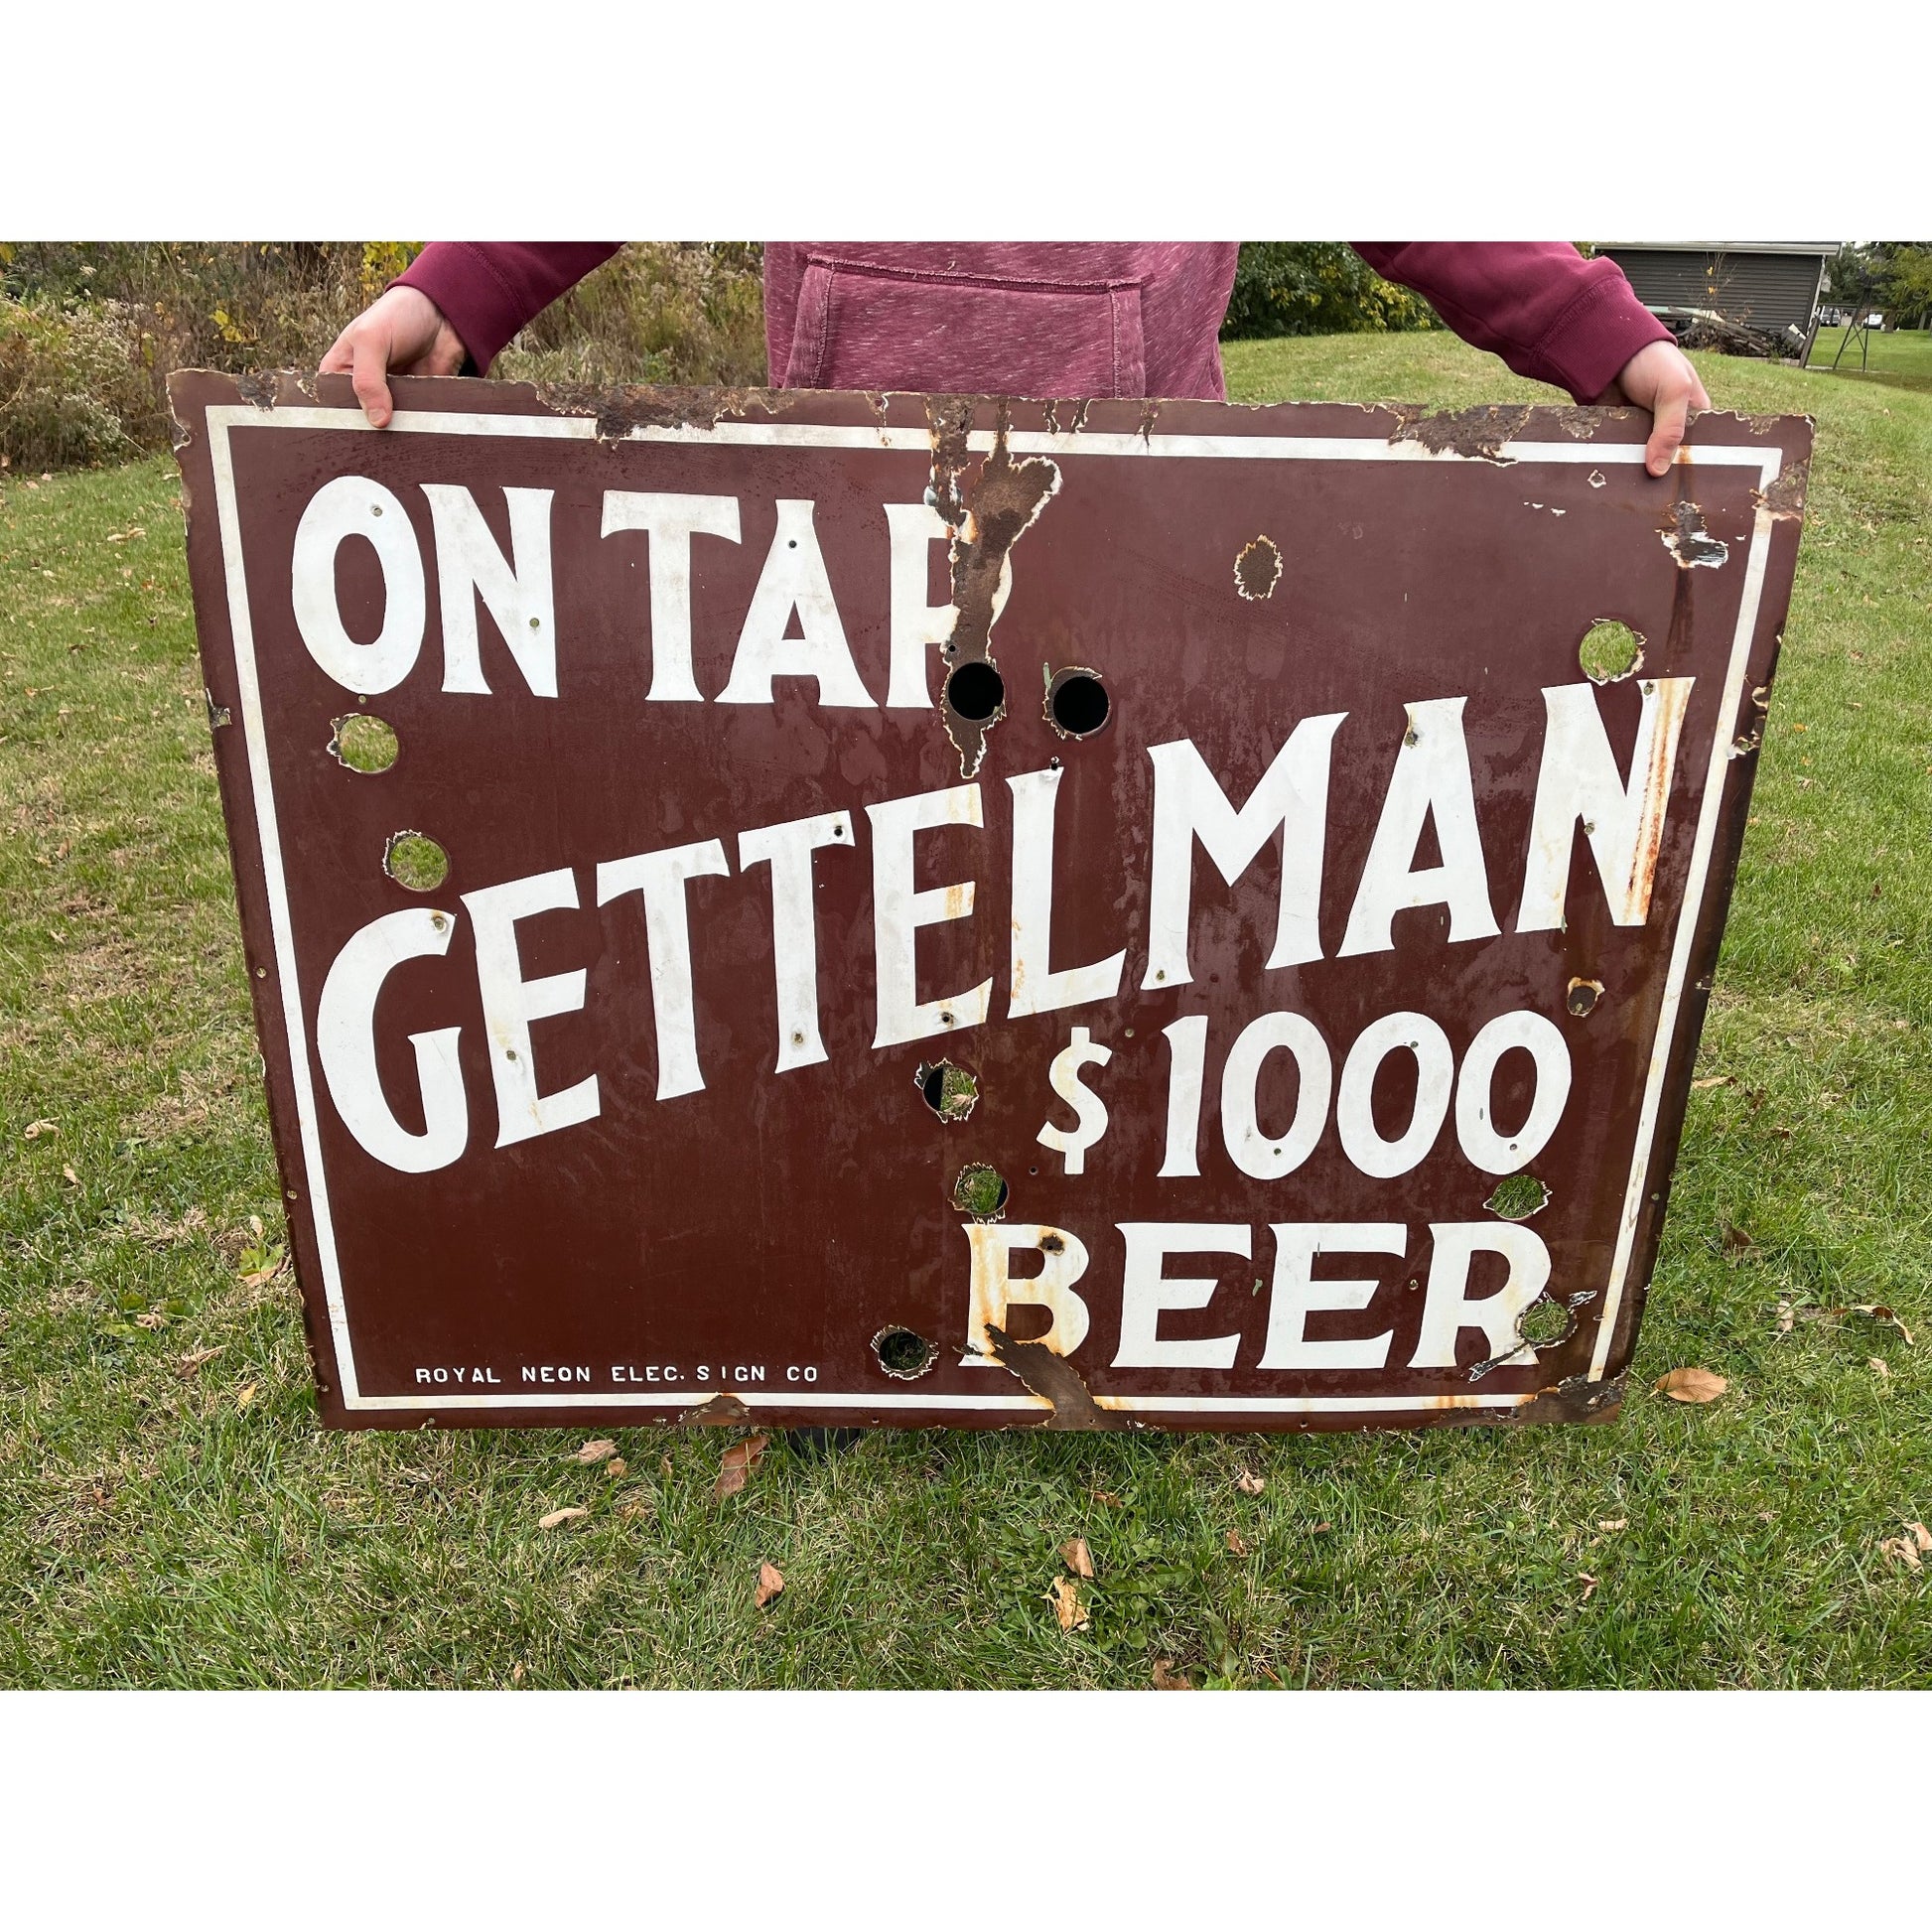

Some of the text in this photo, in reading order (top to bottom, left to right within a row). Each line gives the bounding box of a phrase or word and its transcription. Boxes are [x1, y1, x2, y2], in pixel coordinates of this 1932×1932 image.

[292, 475, 1013, 708] ON TAP
[316, 675, 1695, 1173] GETTELMAN
[415, 1365, 818, 1384] ROYAL NEON ELEC. SIGN CO
[958, 1221, 1552, 1369] BEER
